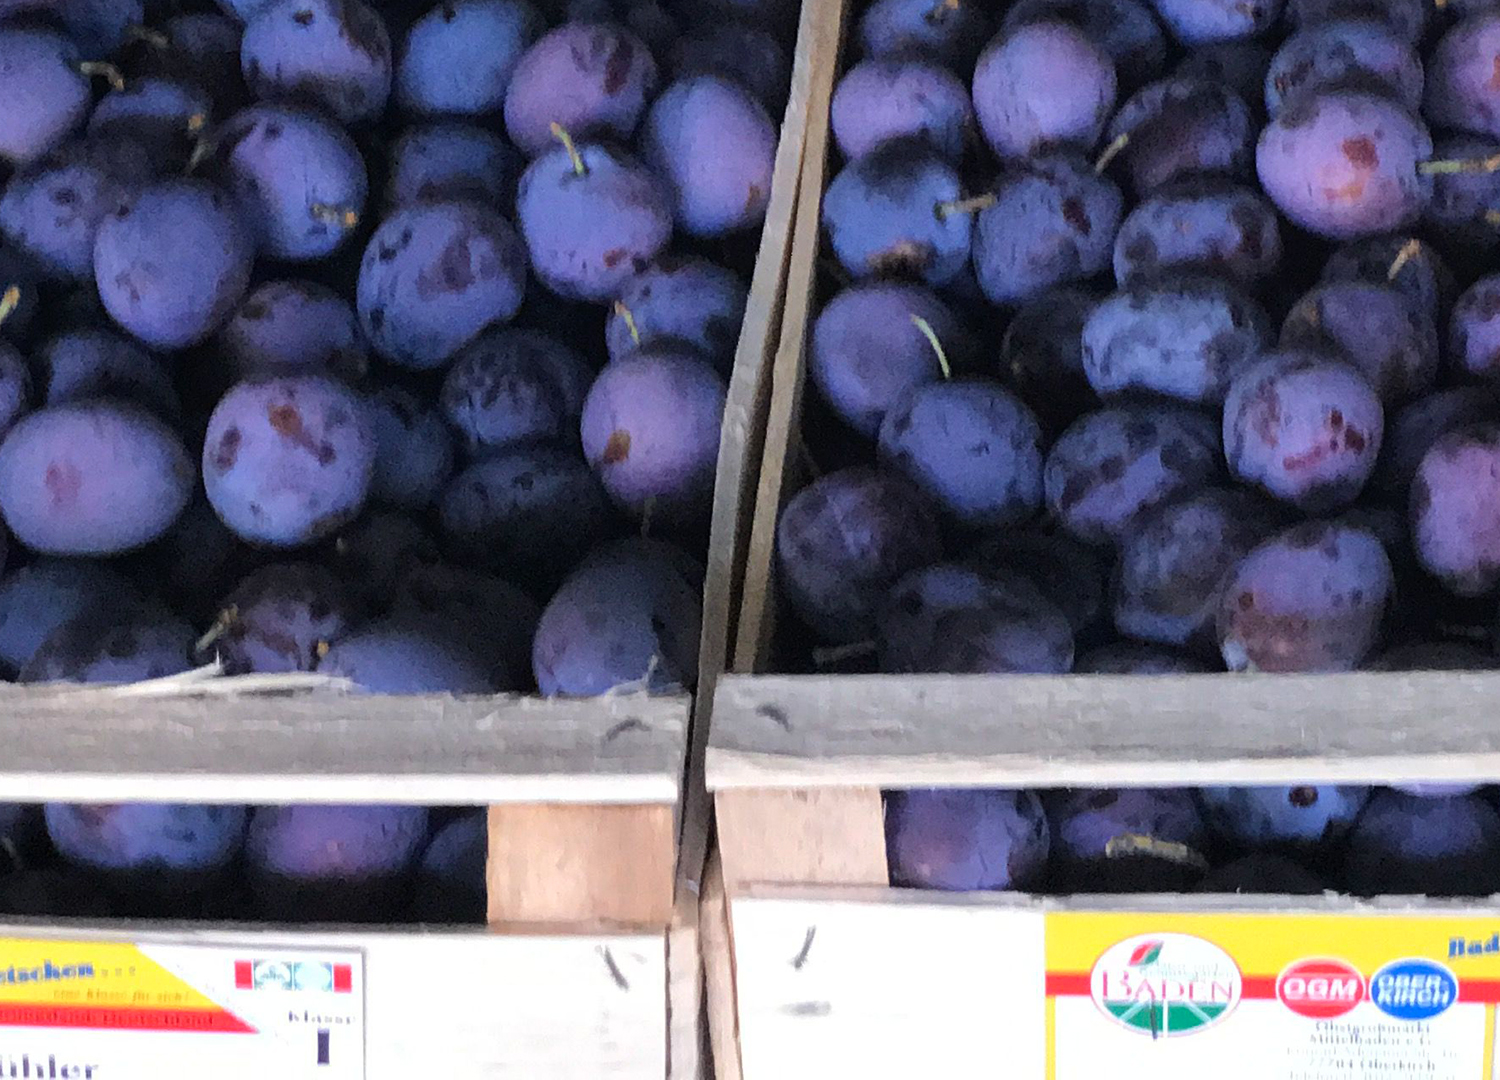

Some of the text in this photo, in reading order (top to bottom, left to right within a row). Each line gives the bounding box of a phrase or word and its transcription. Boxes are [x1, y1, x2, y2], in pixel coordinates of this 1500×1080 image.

[1101, 970, 1233, 1001] BADEN
[1283, 978, 1358, 1002] OGM
[1377, 988, 1450, 1007] KIRCH
